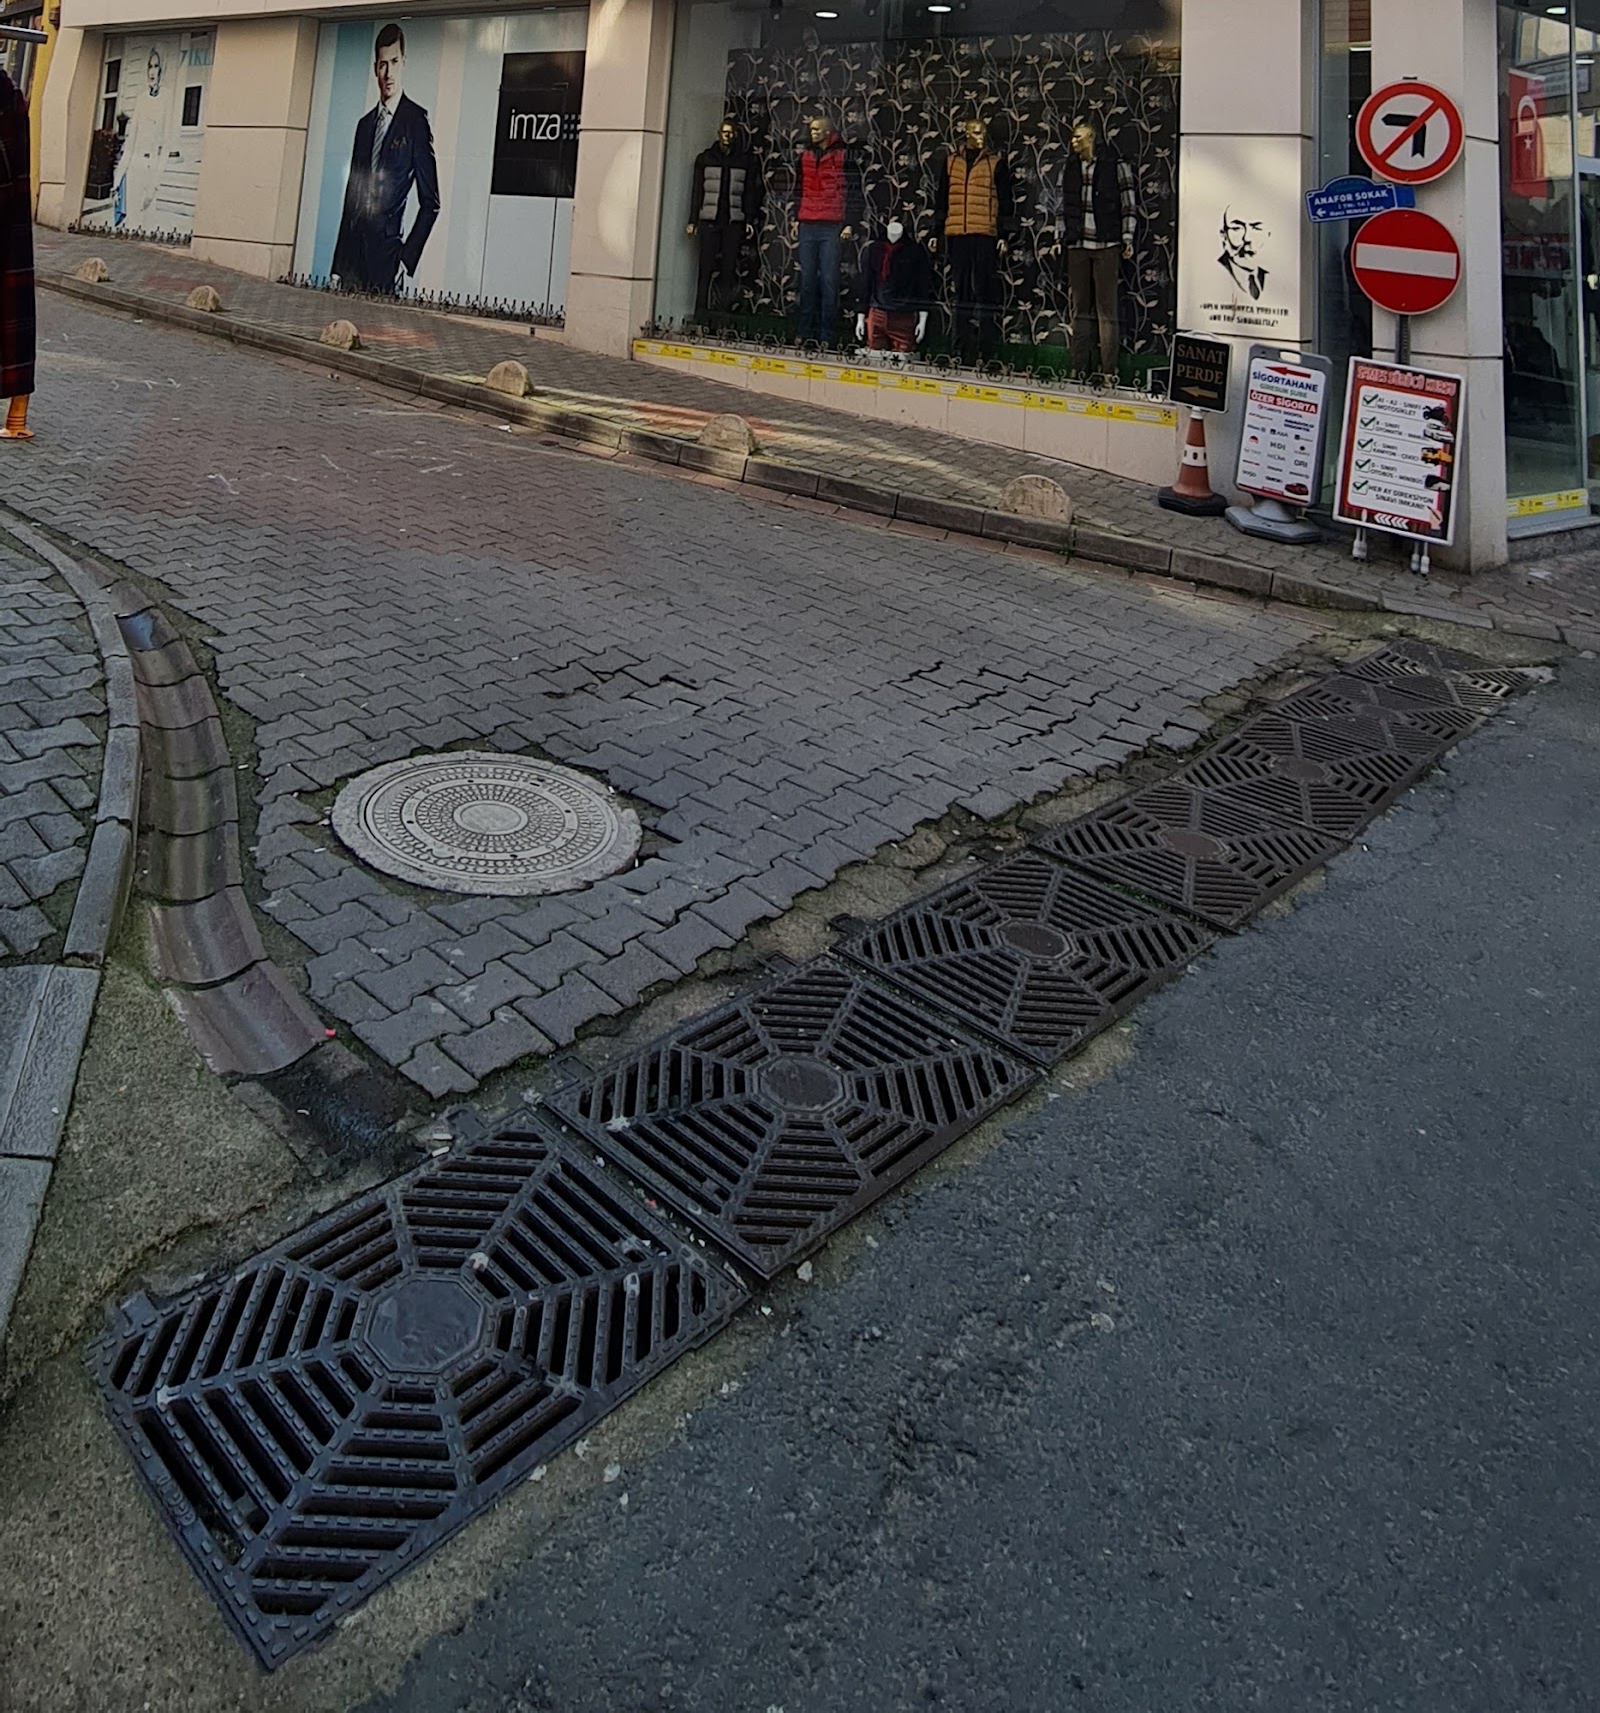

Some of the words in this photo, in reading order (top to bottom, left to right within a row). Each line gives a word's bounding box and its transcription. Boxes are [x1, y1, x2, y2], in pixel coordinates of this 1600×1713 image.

[509, 108, 561, 141] imza
[1314, 193, 1353, 206] ANAFOR
[1354, 189, 1389, 201] SOKAK
[1176, 343, 1226, 365] SANAT
[1175, 363, 1224, 385] PERDE
[1252, 371, 1319, 393] SİGORTAHANE
[1251, 390, 1275, 403] ÖZER
[1275, 396, 1317, 413] SİGORTA
